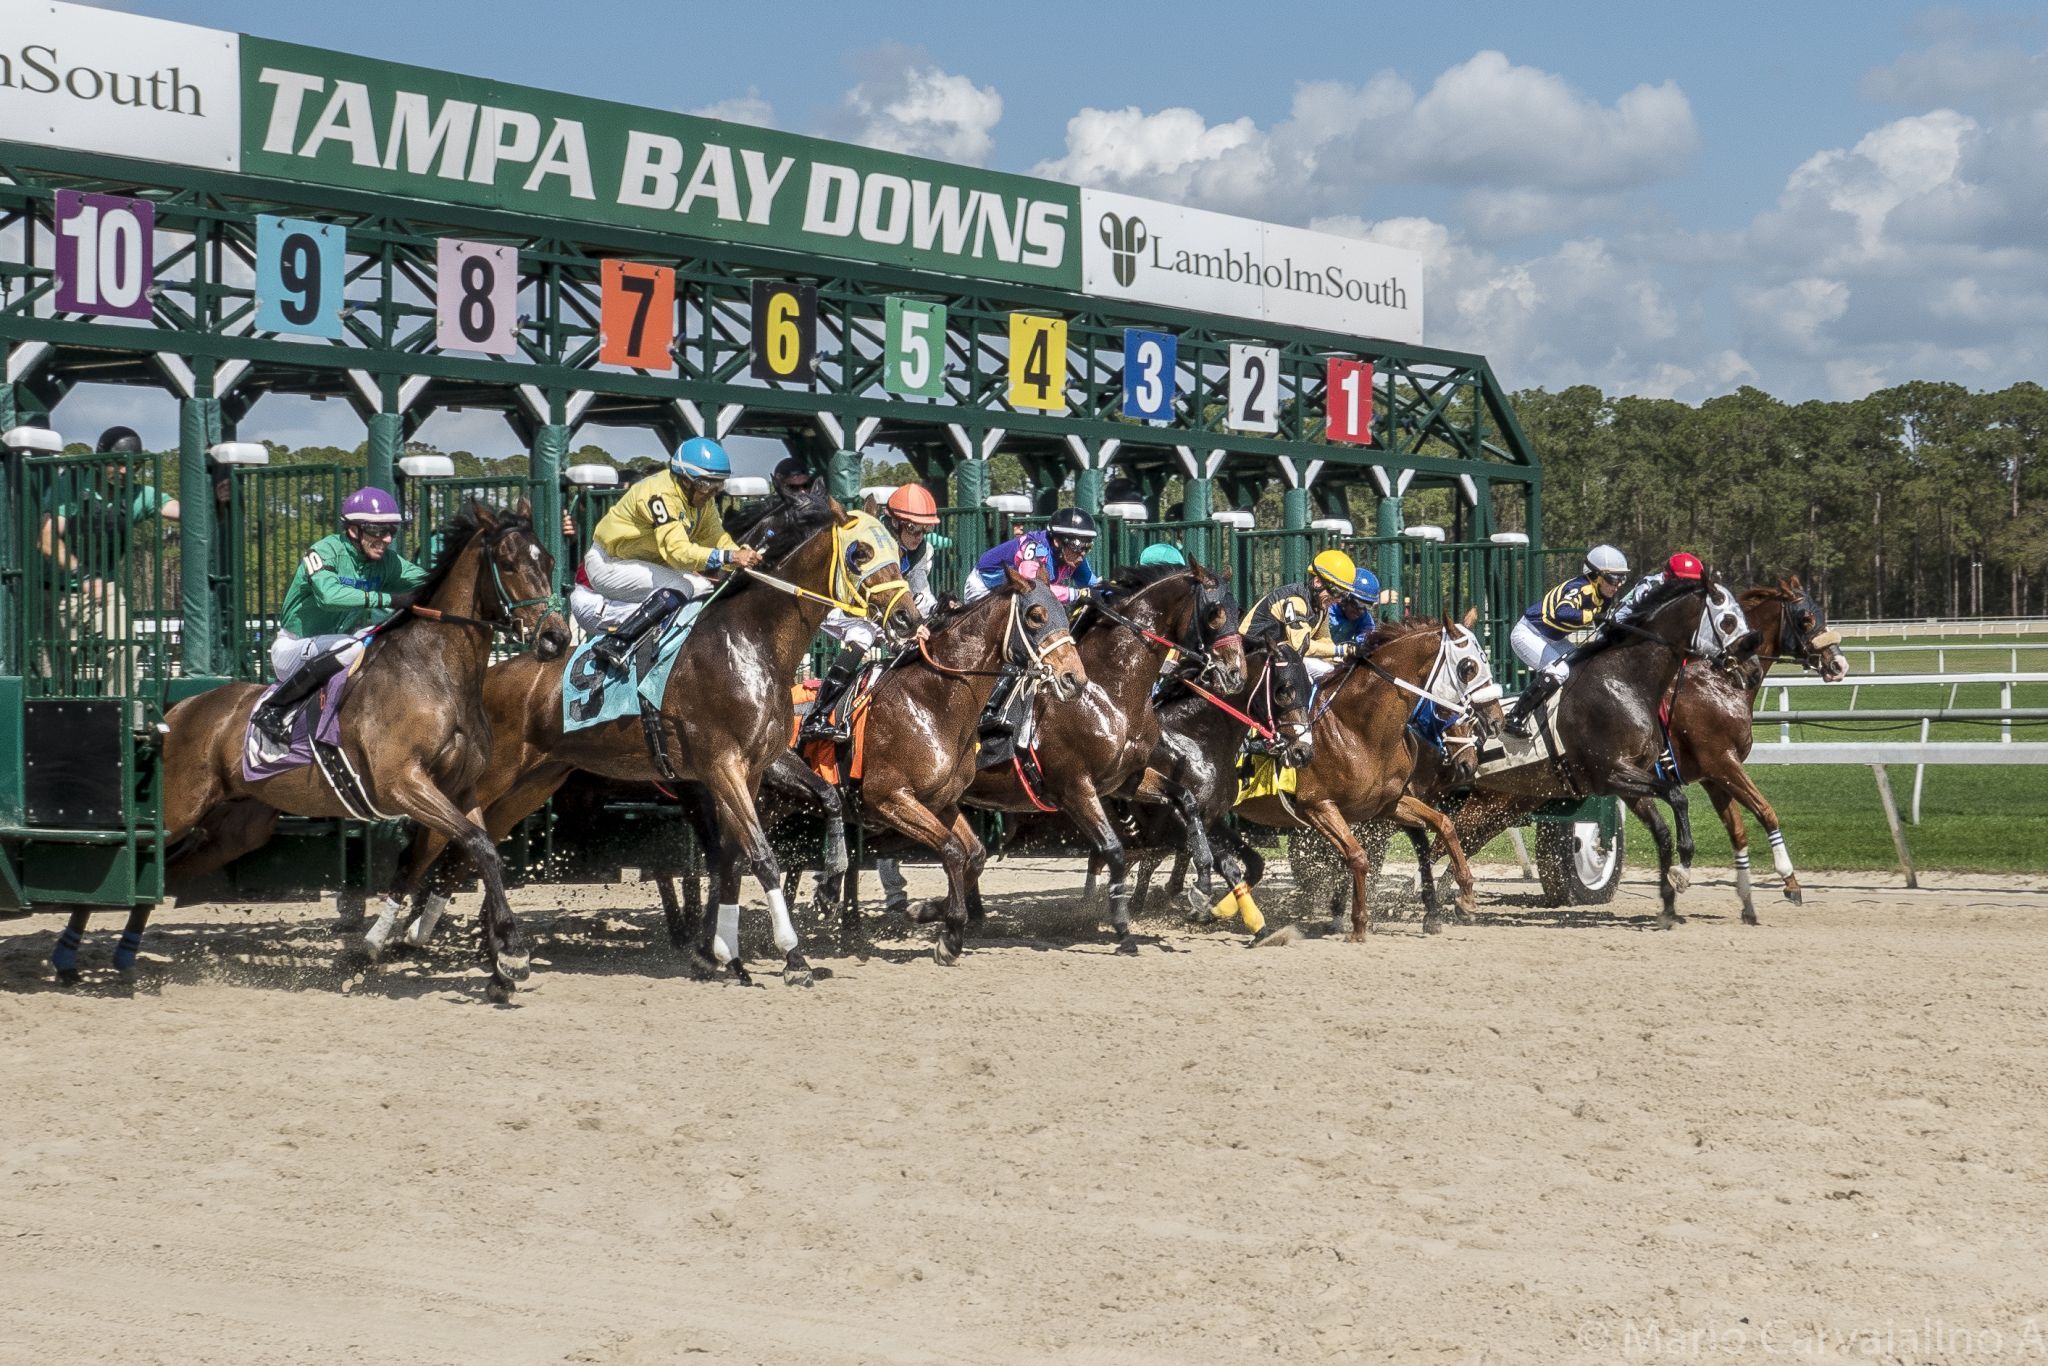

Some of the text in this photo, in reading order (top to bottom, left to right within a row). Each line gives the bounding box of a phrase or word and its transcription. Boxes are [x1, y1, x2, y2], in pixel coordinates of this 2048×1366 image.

[258, 67, 1069, 269] TAMPA BAY DOWNS
[61, 205, 143, 308] 10
[279, 232, 321, 326] 9
[1149, 235, 1409, 310] LambholmSouth
[458, 254, 496, 344] 8
[620, 275, 655, 358] 7
[765, 292, 801, 375] 6
[899, 310, 930, 389] 5
[1023, 328, 1051, 400] 4
[1136, 340, 1163, 414] 3
[1242, 355, 1265, 424] 2
[1341, 369, 1362, 436] 1
[652, 500, 669, 524] 9
[303, 550, 324, 576] 10
[1023, 542, 1037, 561] 6
[1563, 588, 1580, 601] 2
